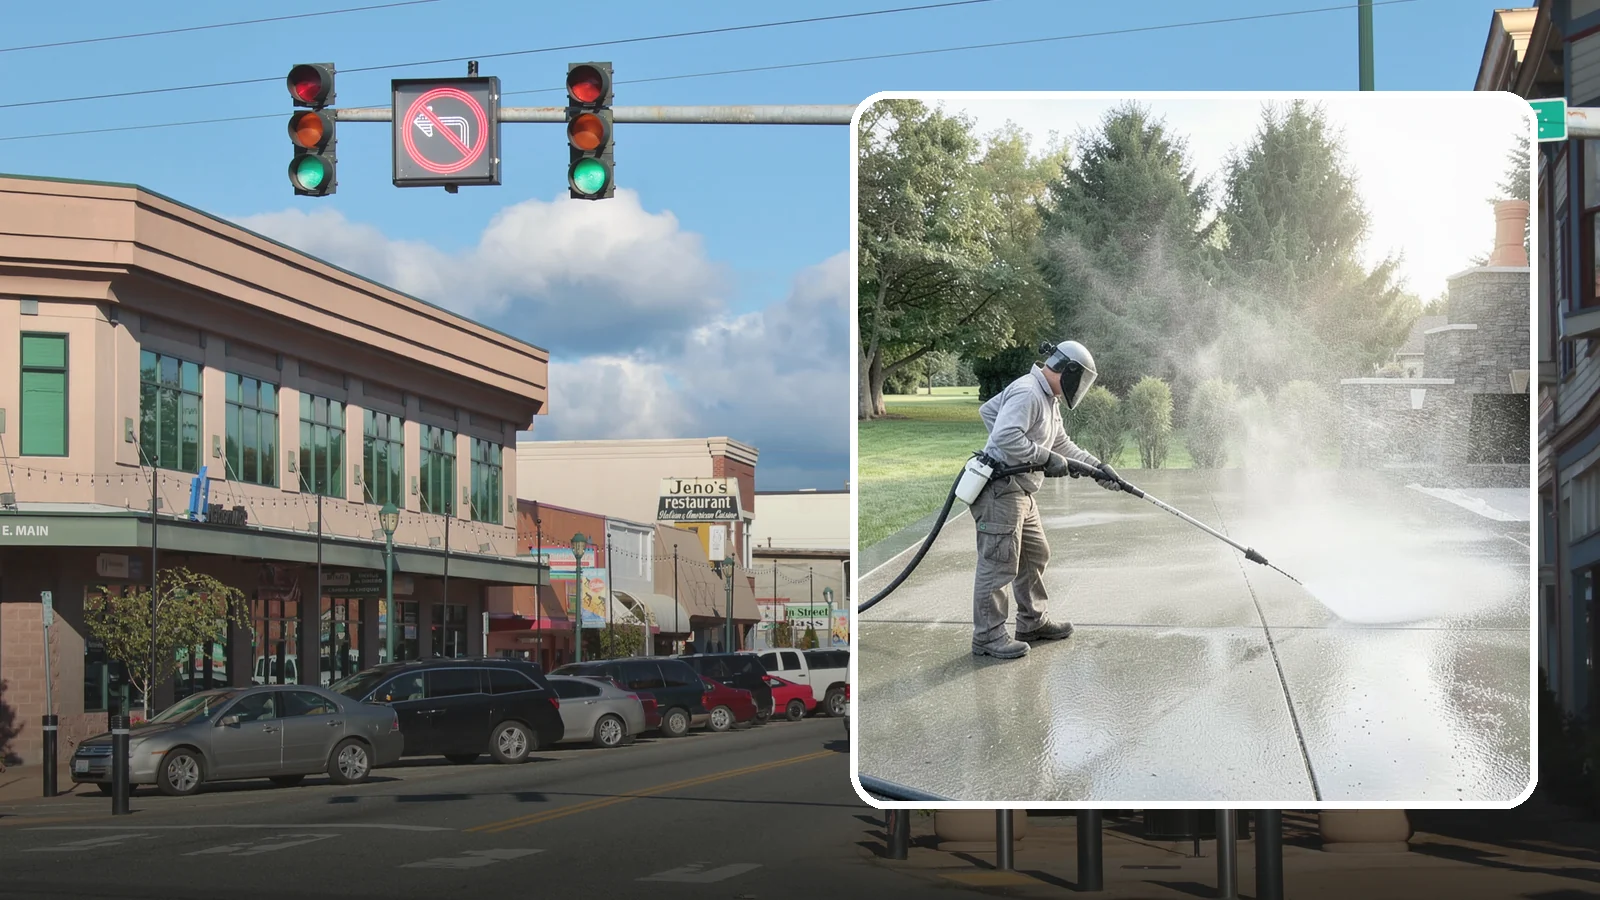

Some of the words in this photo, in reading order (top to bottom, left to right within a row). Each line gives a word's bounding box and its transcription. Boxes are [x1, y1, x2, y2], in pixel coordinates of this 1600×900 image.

[670, 480, 727, 494] Jeno's
[665, 496, 731, 509] restaurant
[659, 510, 681, 519] Italian
[686, 510, 714, 519] American
[715, 509, 737, 519] Cuisine
[2, 525, 13, 536] E.
[15, 525, 49, 536] MAIN
[797, 607, 828, 616] Street
[790, 619, 823, 627] lass
